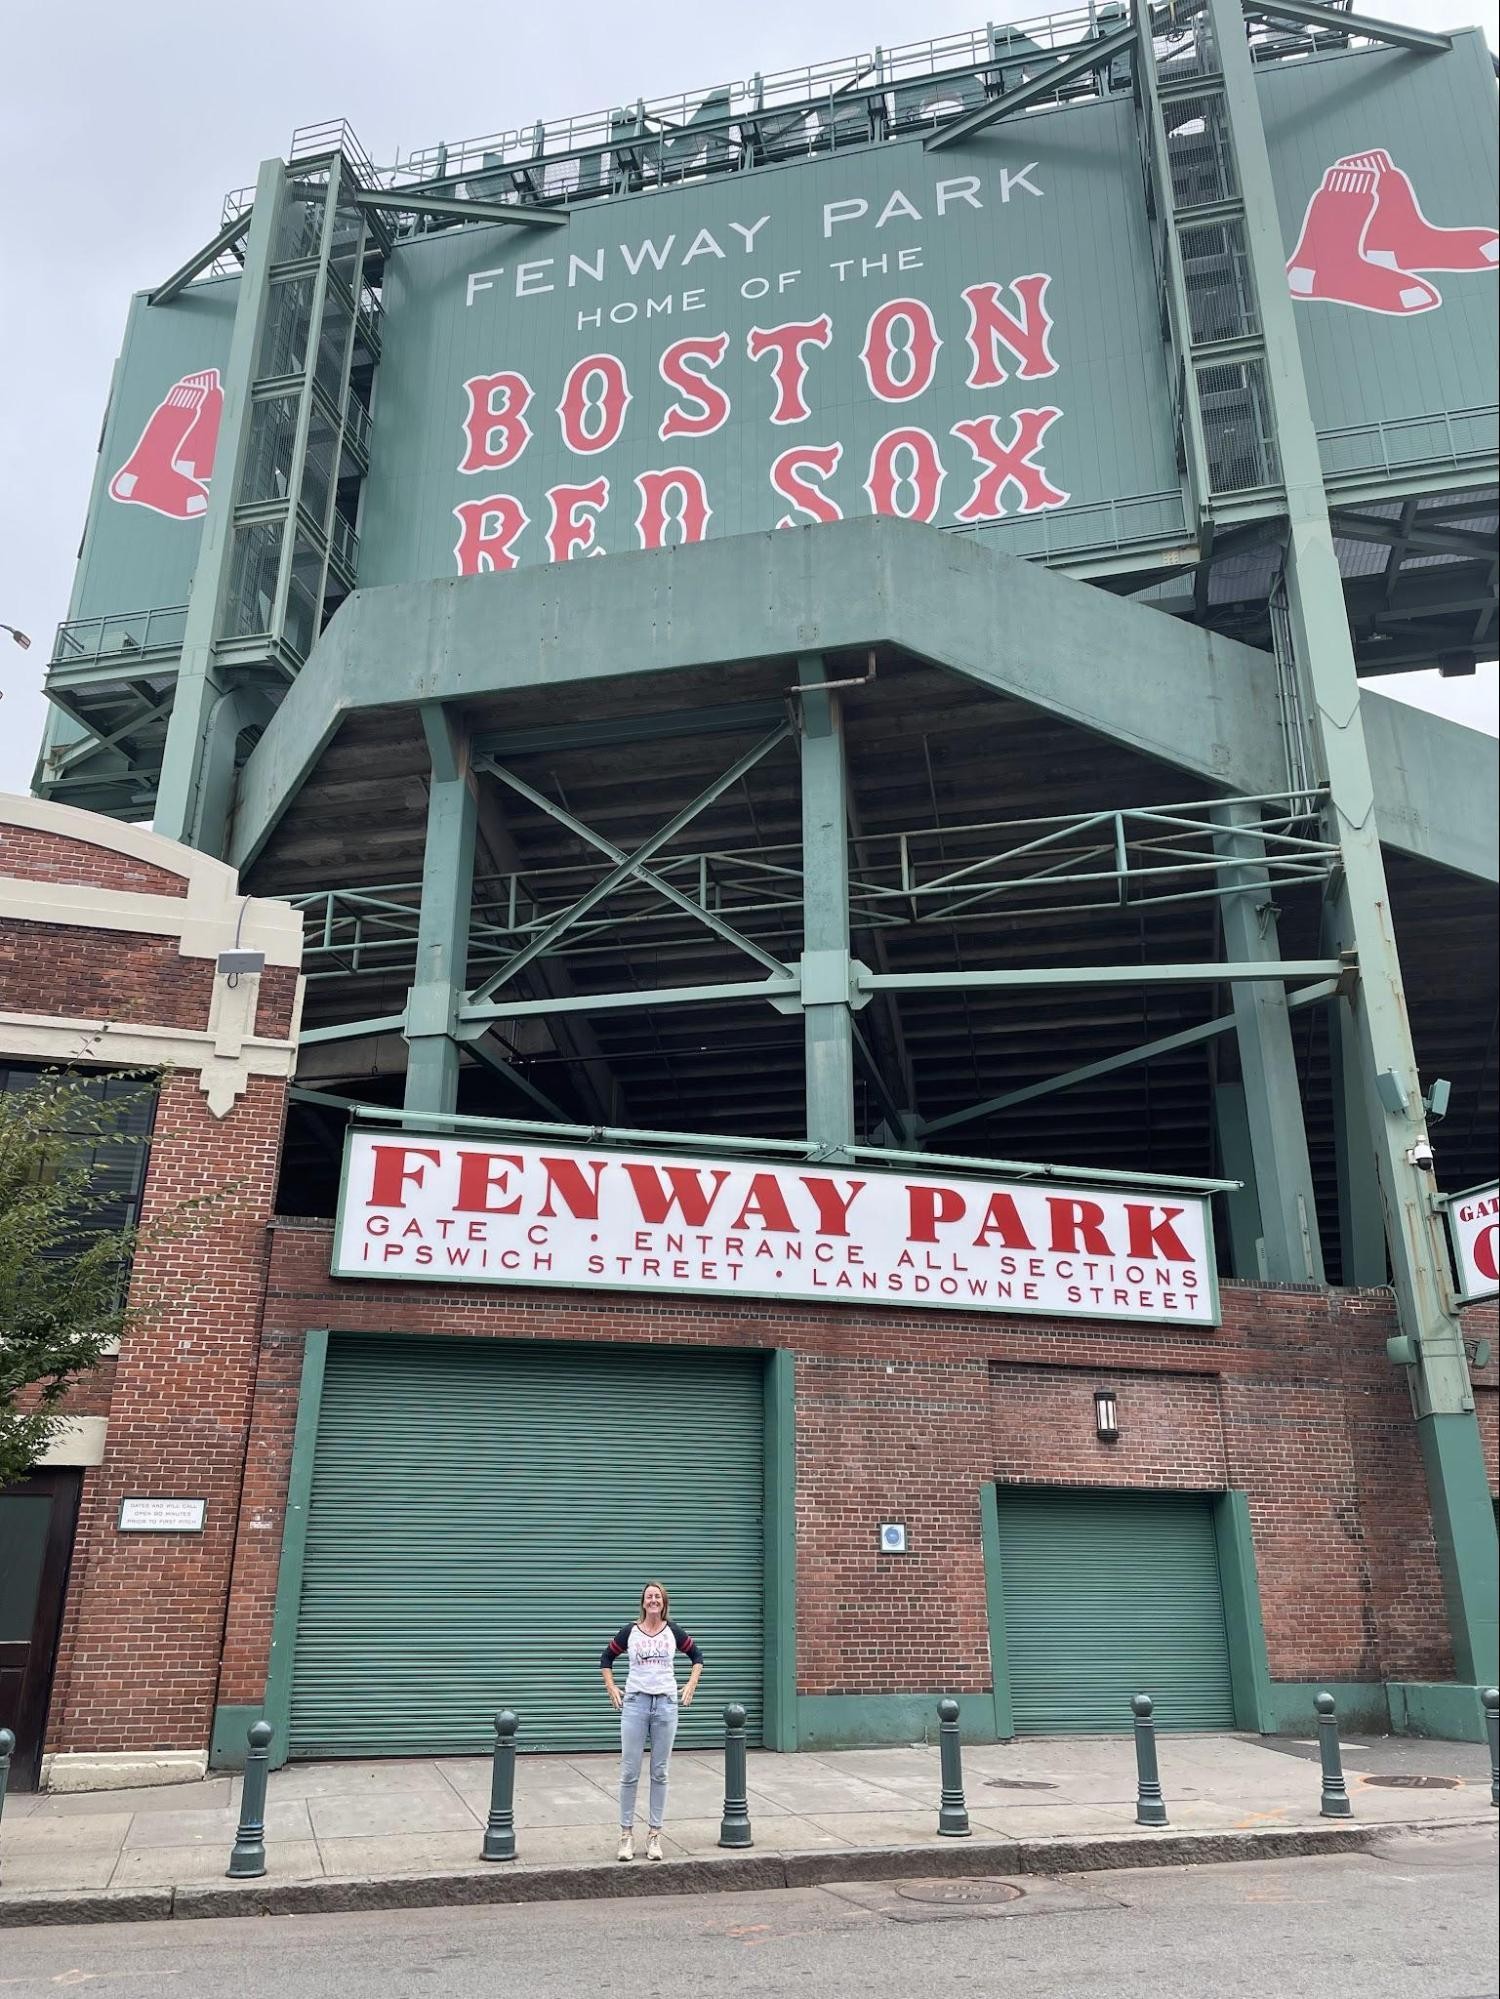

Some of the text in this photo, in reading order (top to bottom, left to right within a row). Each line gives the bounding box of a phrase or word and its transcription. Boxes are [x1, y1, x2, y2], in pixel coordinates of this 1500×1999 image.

[465, 161, 1044, 307] FENWAY PARK
[577, 246, 924, 331] HOME OF THE
[456, 272, 1060, 475] BOSTON
[452, 405, 1072, 577] RED SOX
[365, 1145, 1196, 1263] FENWAY PARK
[366, 1215, 1198, 1288] GATE C ENTRANCE ALL SECTIONS
[1459, 1197, 1500, 1223] GAT
[363, 1242, 1200, 1311] IPSWICH STREET LANSDOWNE STREET
